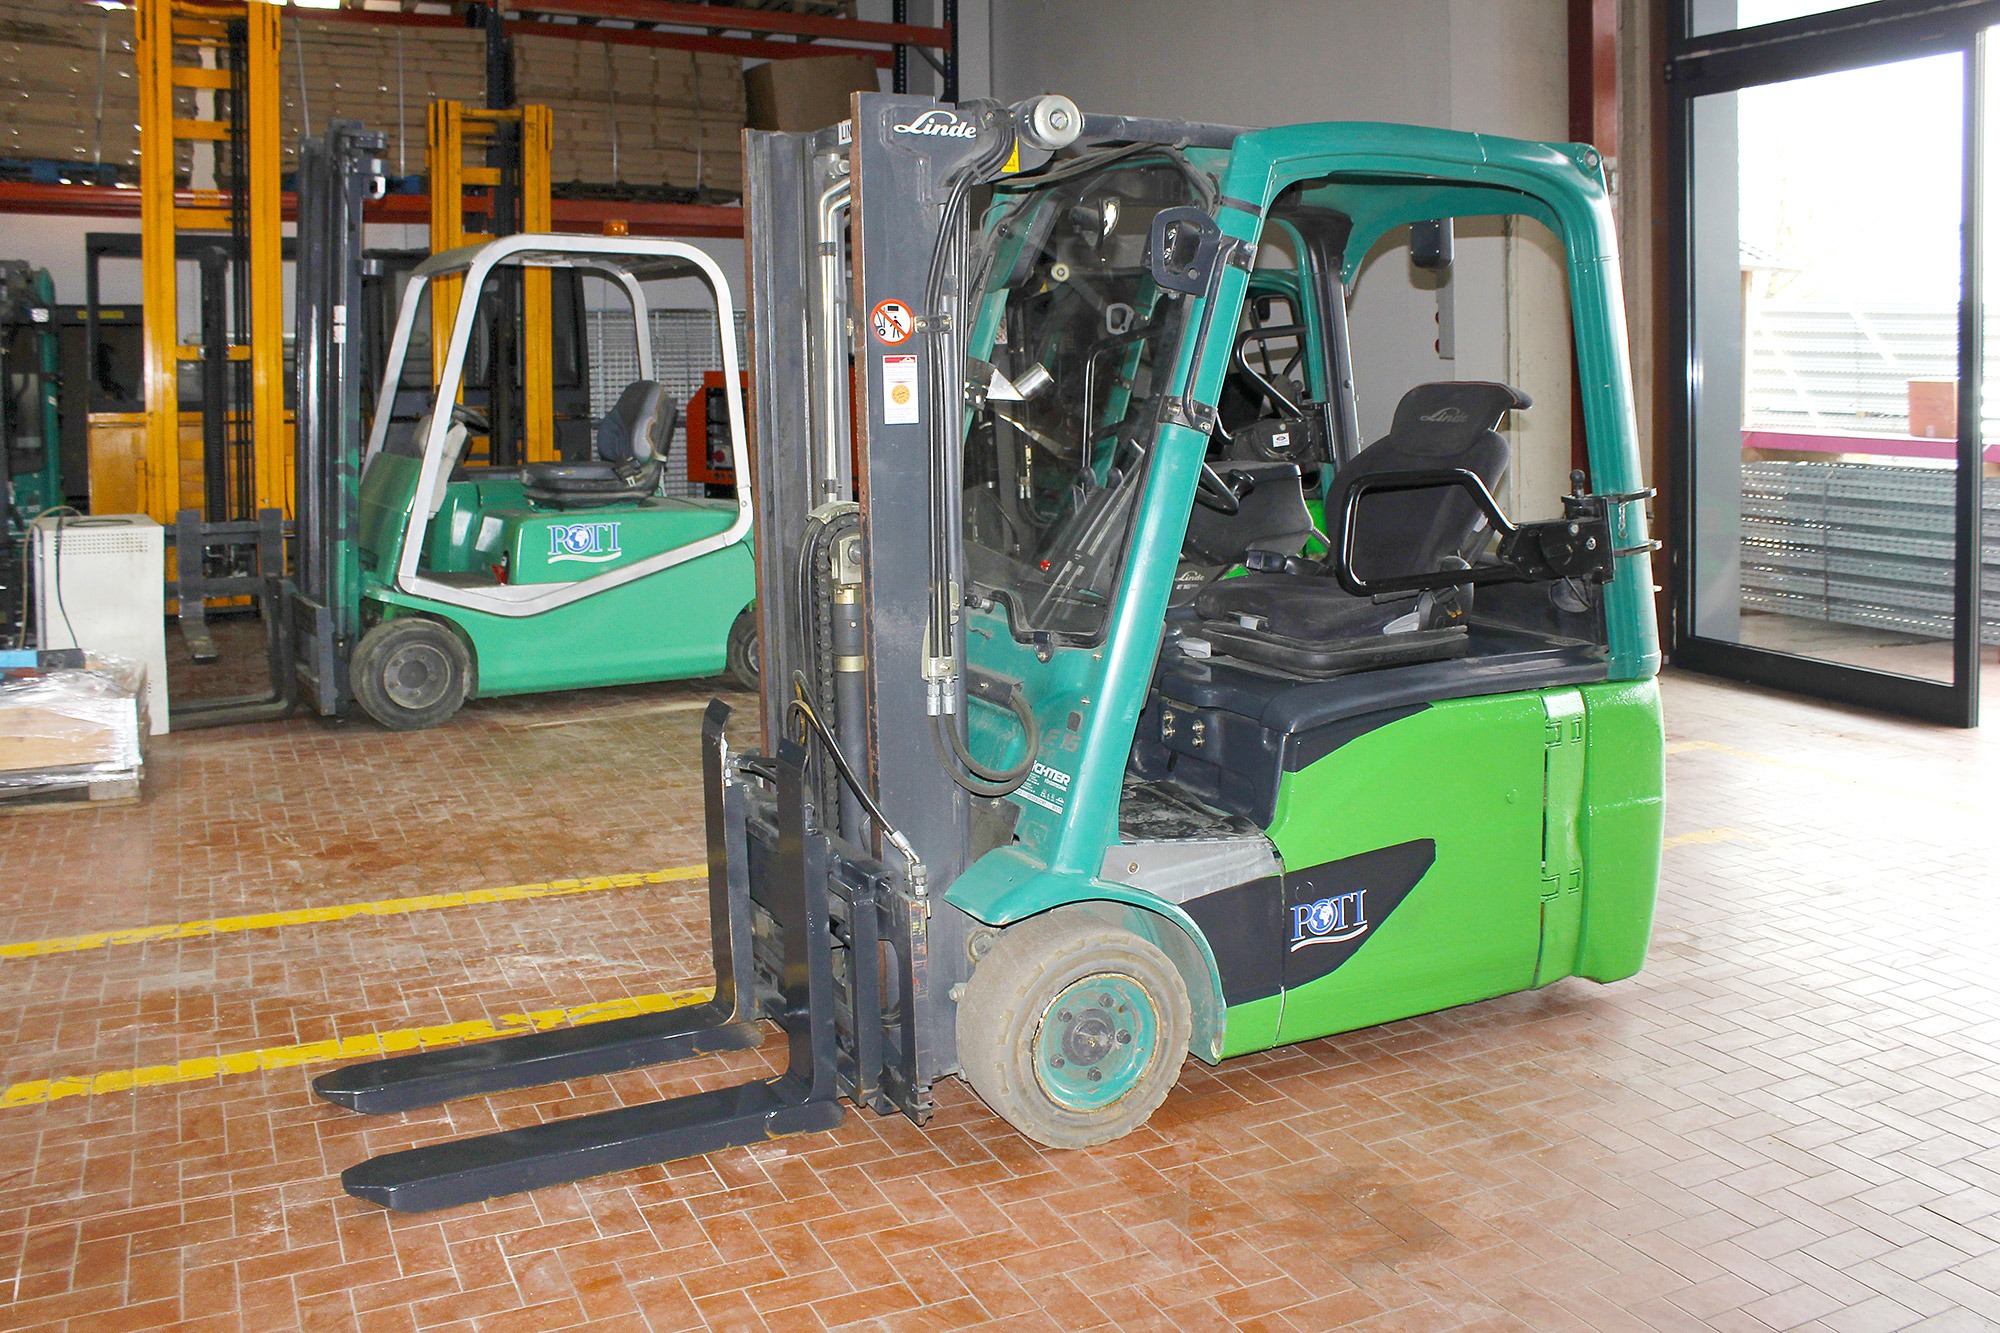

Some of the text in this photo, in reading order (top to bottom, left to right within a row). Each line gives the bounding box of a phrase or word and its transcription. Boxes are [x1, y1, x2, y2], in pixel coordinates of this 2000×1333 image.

[893, 110, 977, 139] Linde
[1419, 407, 1469, 422] Linde
[546, 522, 622, 555] POTI
[1174, 570, 1205, 581] Linde
[1290, 889, 1368, 942] POTI
